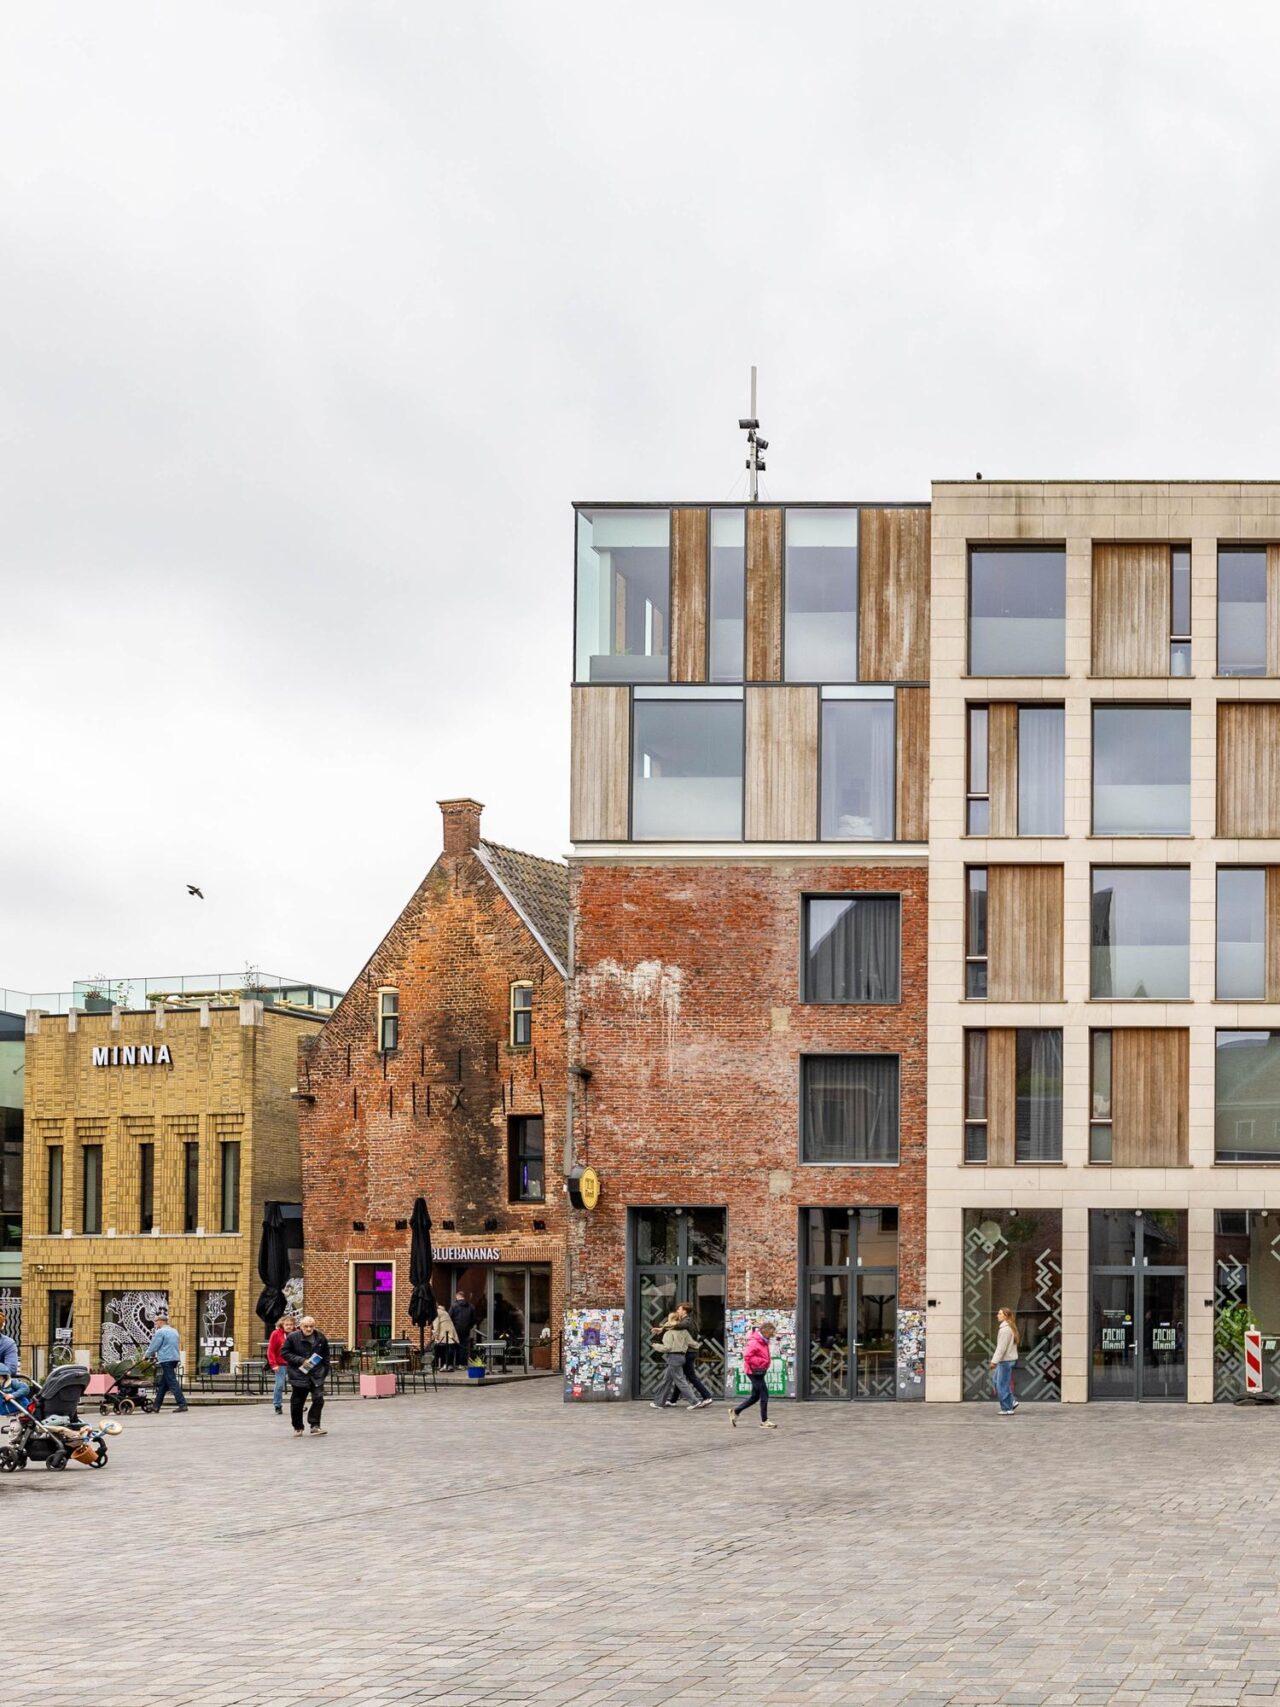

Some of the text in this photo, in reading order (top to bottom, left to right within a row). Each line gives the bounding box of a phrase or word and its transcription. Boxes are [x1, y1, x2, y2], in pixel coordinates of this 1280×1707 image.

[92, 1045, 171, 1066] MINNA
[200, 1336, 234, 1347] LET'S
[205, 1346, 229, 1357] EAT
